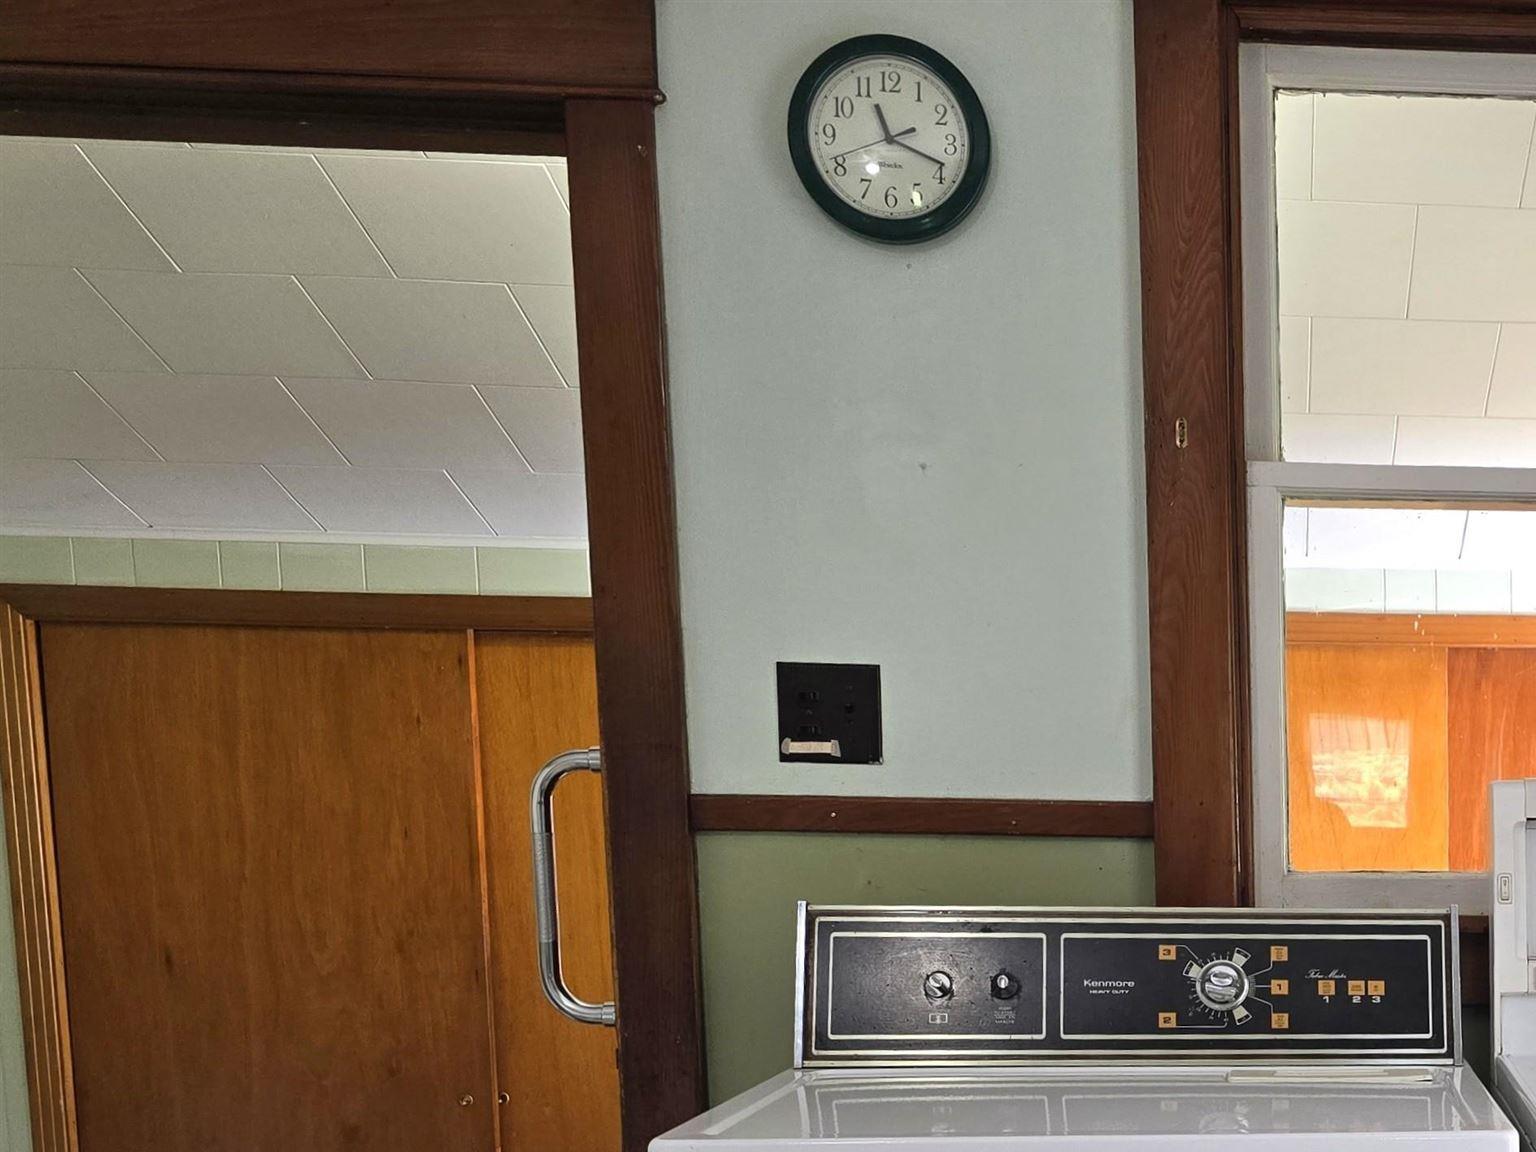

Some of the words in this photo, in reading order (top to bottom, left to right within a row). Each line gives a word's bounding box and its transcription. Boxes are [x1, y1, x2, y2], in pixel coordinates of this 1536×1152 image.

[855, 76, 872, 98] 11
[879, 71, 901, 93] 12
[915, 82, 922, 103] 1
[834, 96, 854, 119] 10
[934, 104, 948, 125] 2
[822, 123, 836, 146] 9
[944, 133, 957, 156] 3
[834, 155, 847, 176] 8
[932, 163, 946, 185] 4
[859, 178, 872, 200] 7
[884, 186, 898, 208] 6
[1162, 948, 1171, 956] 3
[1083, 979, 1135, 987] Kenmore
[1322, 996, 1329, 1004] 1
[1352, 996, 1361, 1004] 2
[1371, 996, 1381, 1004] 3
[1162, 1016, 1172, 1024] 2
